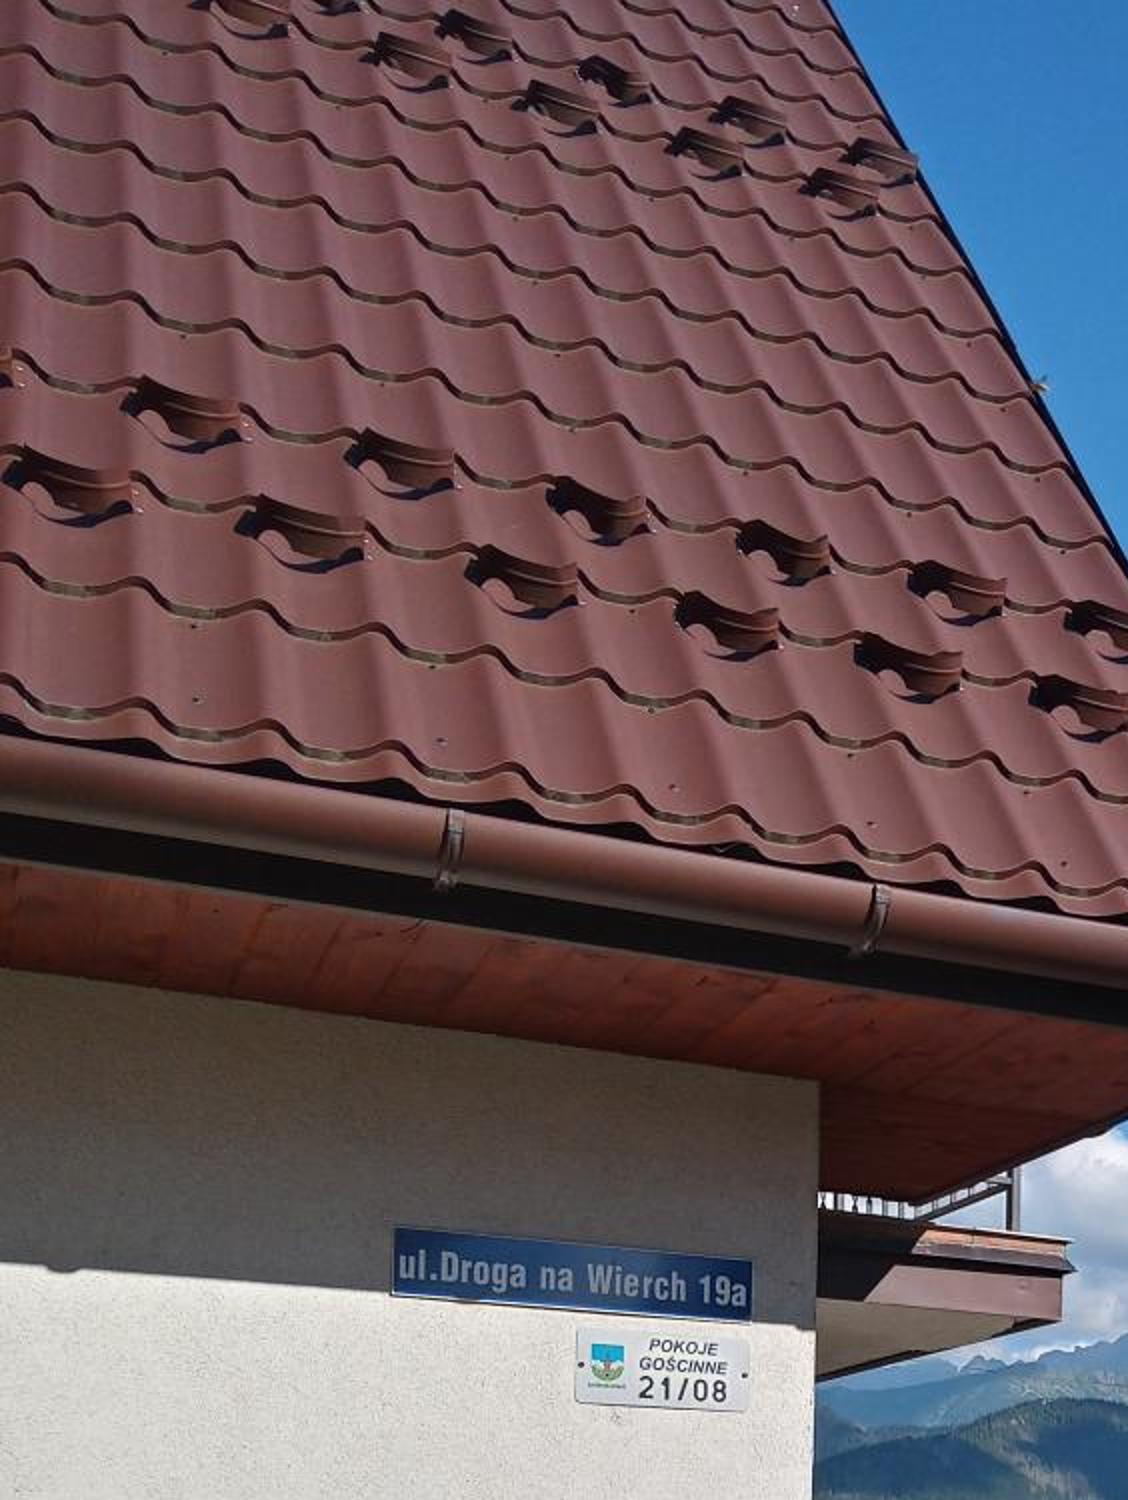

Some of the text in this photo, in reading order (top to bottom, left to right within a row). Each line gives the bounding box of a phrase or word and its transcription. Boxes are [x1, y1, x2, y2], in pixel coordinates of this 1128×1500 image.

[539, 1264, 574, 1291] na
[587, 1262, 687, 1303] Wierch
[699, 1273, 746, 1307] 19a
[649, 1338, 719, 1357] POKOJE
[639, 1356, 727, 1375] GOŚCINNE
[638, 1376, 727, 1403] 21/08
